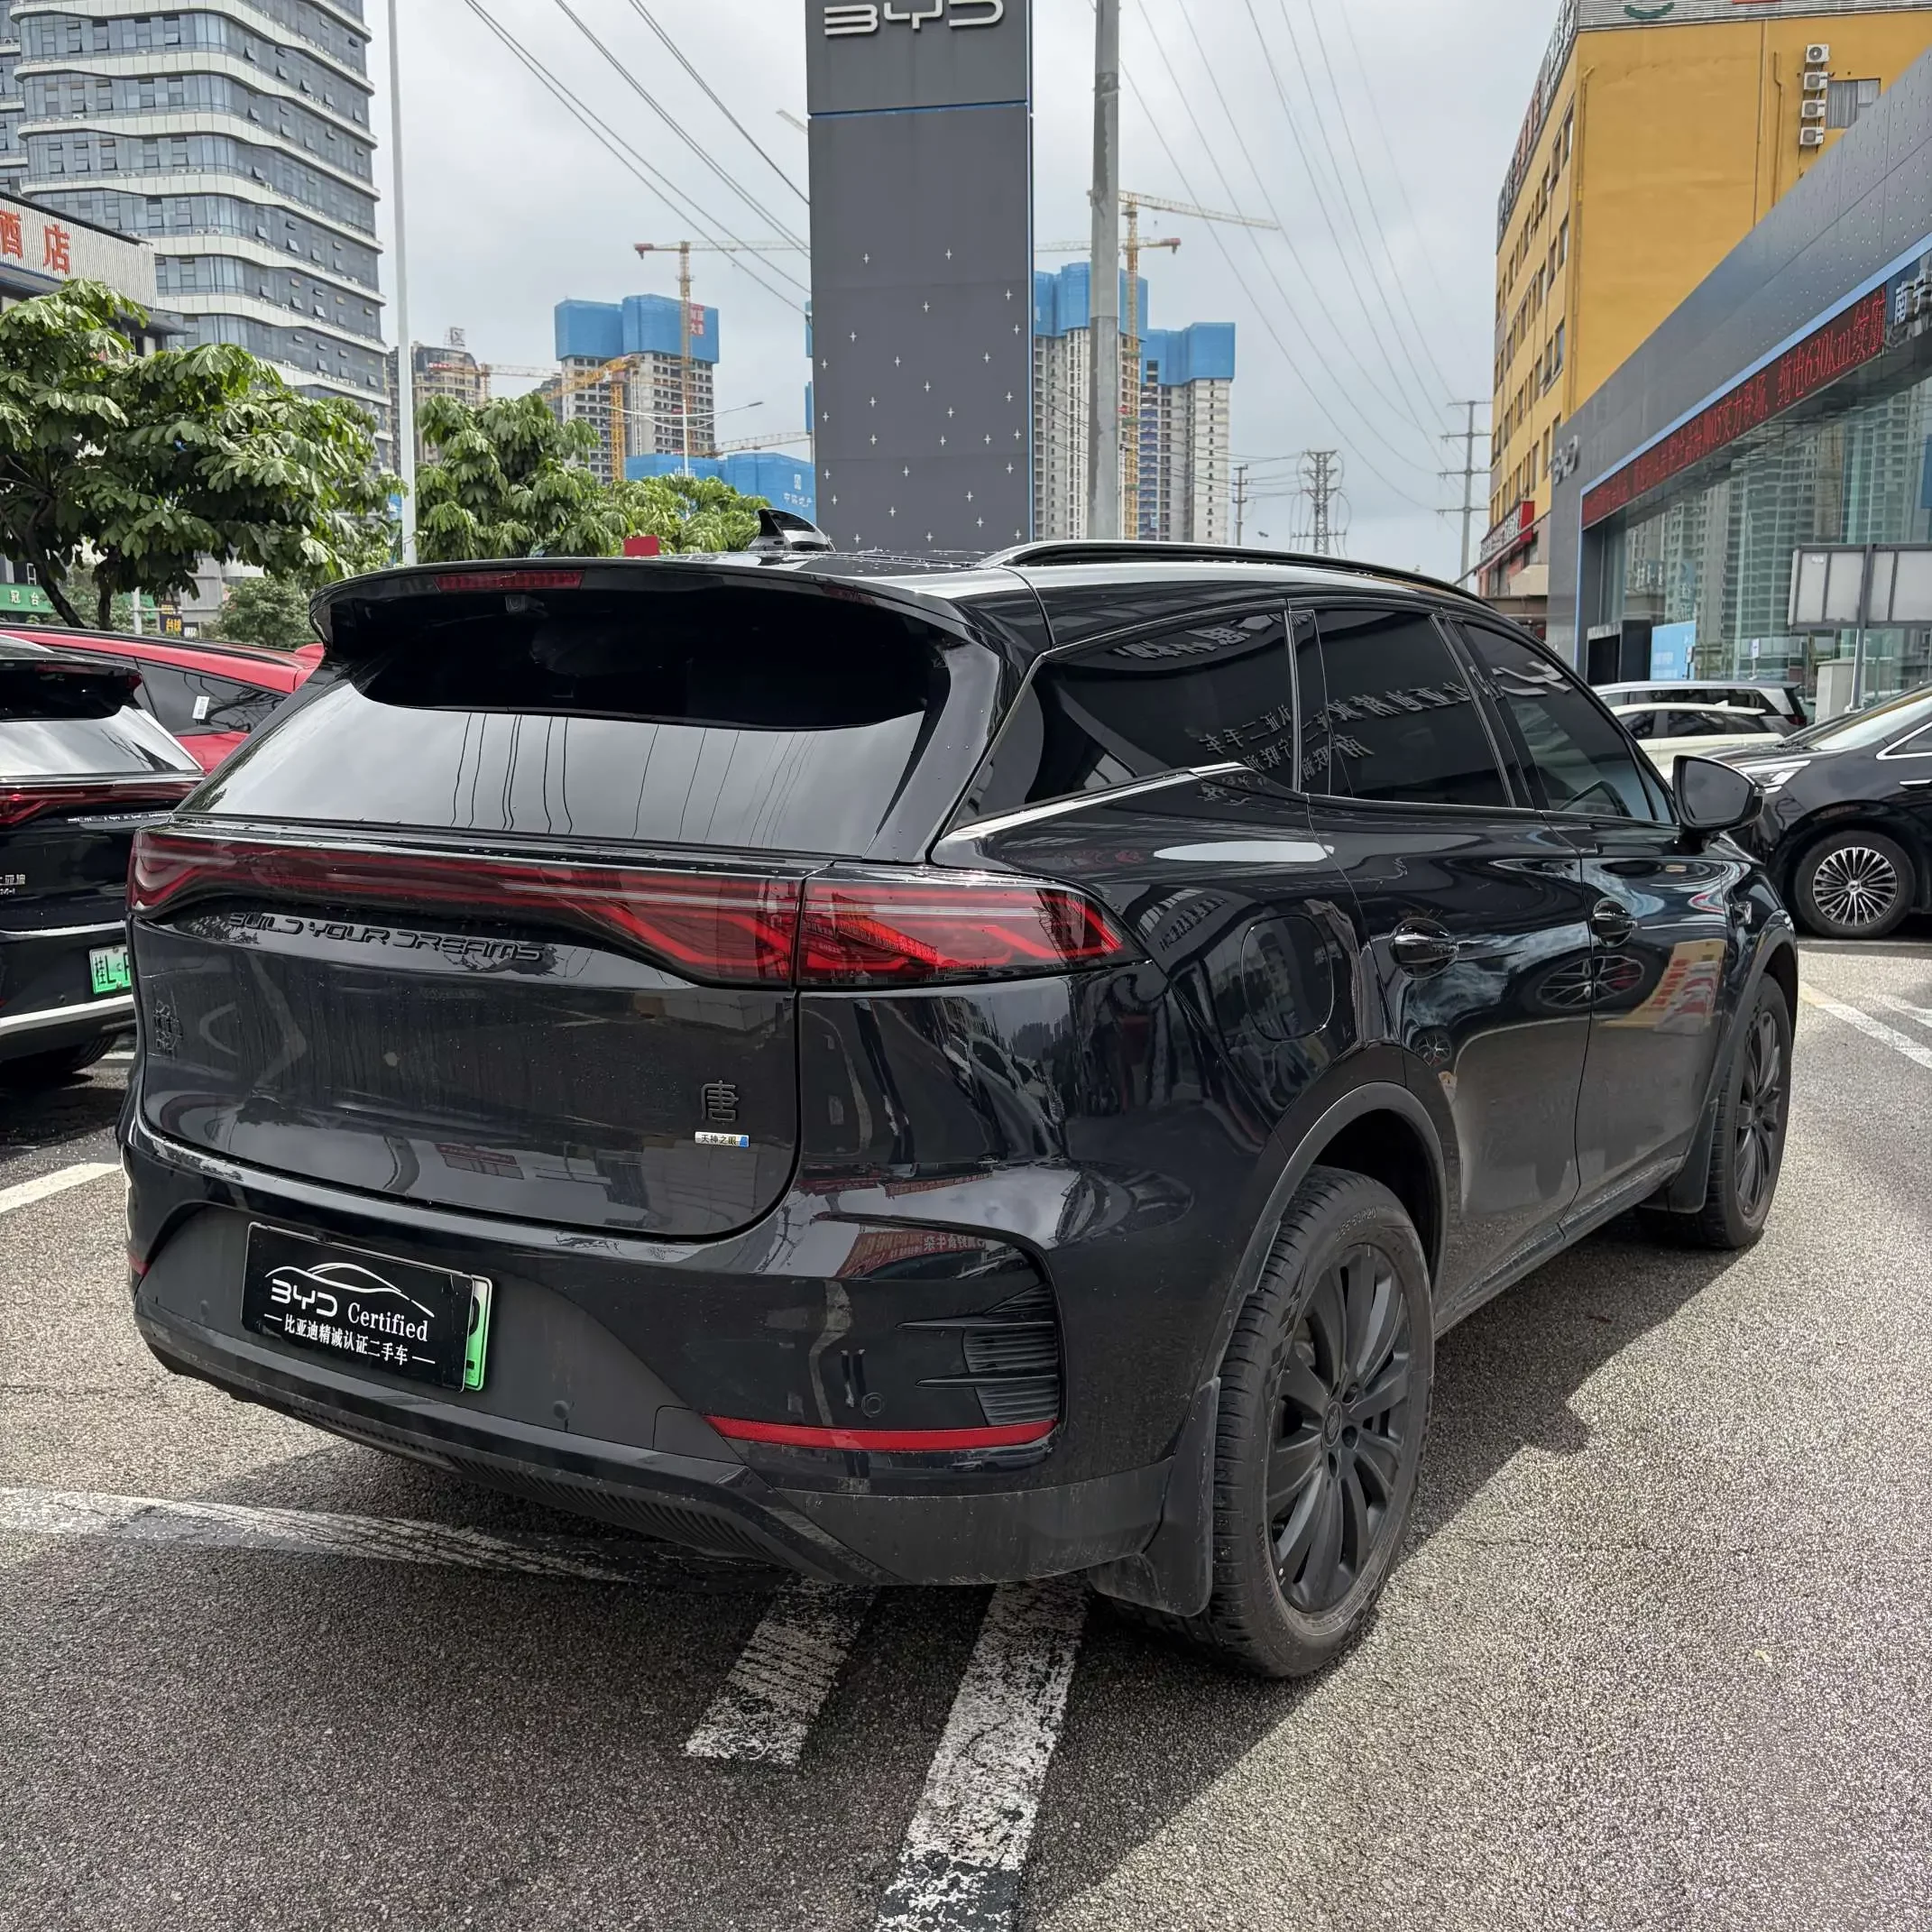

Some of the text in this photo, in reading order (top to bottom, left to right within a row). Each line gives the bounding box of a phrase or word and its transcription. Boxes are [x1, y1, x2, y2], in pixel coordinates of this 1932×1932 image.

[823, 0, 1004, 36] BYD
[228, 912, 545, 961] BUILD YOUR DREAMS
[701, 1080, 740, 1122] 唐
[271, 1278, 428, 1342] BYD Certified
[283, 1313, 409, 1366] 比亚迪精诚认证二手车
